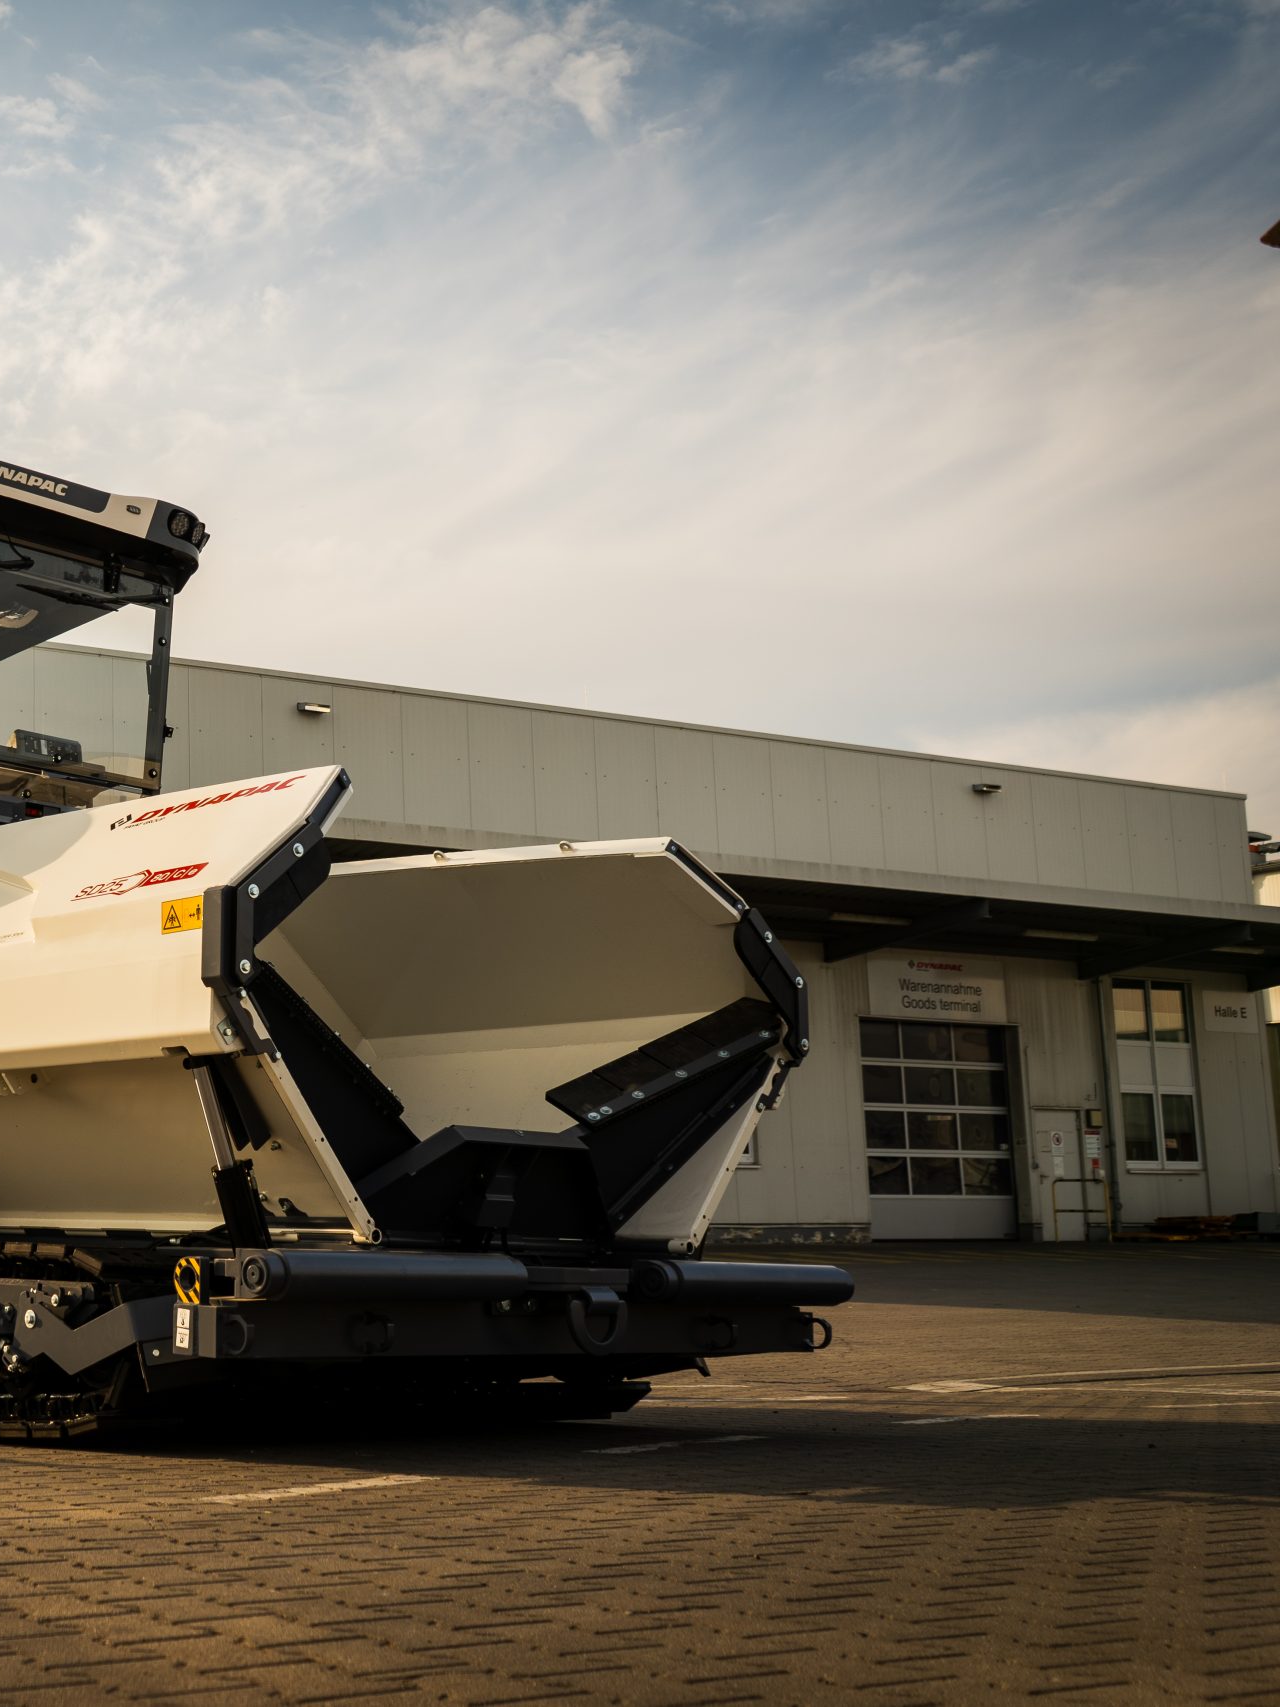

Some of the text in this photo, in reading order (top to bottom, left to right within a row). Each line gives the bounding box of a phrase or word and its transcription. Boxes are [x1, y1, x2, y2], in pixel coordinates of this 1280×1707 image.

[131, 775, 306, 824] DYNAPAC
[75, 878, 129, 898] SD25
[899, 979, 982, 996] Warenannahme
[901, 995, 982, 1013] Goods terminal
[1214, 1005, 1248, 1019] Halle E
